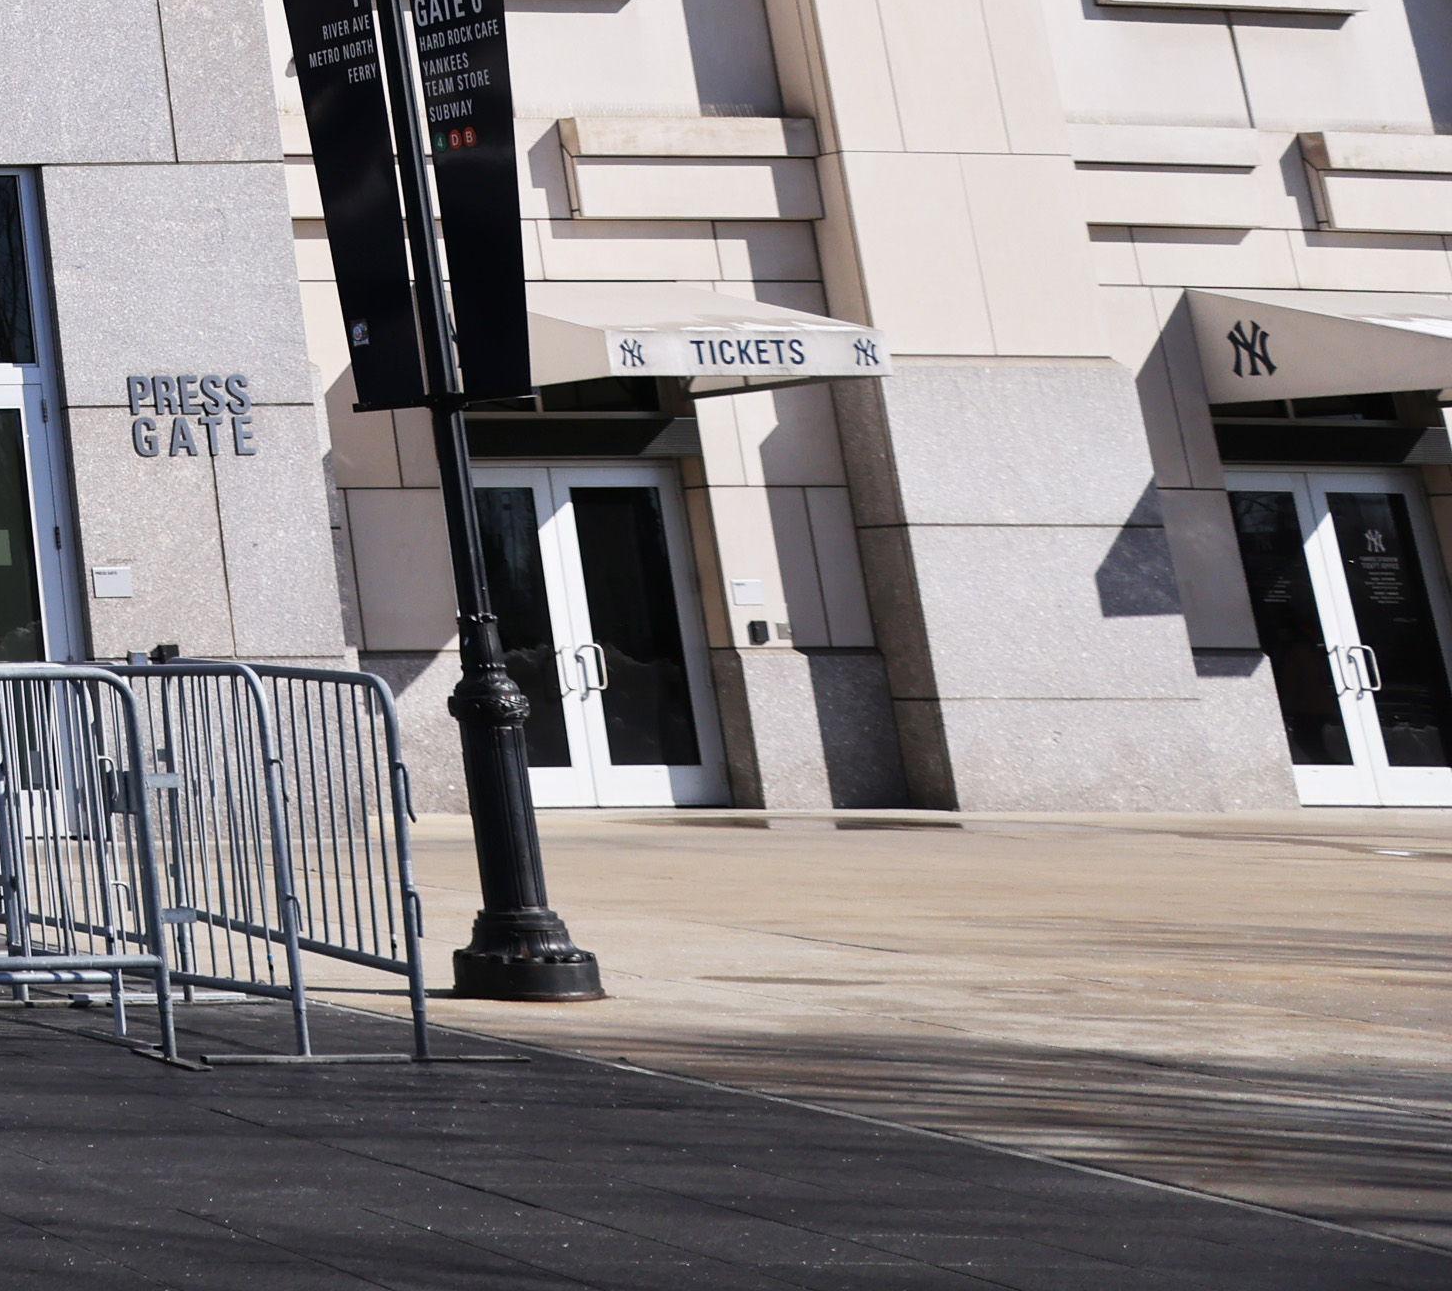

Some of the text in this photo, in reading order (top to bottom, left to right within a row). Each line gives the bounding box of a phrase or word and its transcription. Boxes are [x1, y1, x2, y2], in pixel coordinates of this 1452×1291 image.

[322, 14, 371, 41] RIVER AVE
[419, 19, 500, 52] HARD ROCK CAFE
[309, 38, 374, 69] METRO NORTH
[422, 52, 469, 77] YANKEES
[348, 62, 377, 84] FERRY
[425, 69, 491, 97] TEAM STORE
[429, 99, 473, 123] SUBWAY
[452, 131, 459, 146] D
[465, 131, 473, 143] B
[690, 339, 805, 365] TICKETS
[127, 374, 252, 416] PRESS
[131, 416, 257, 457] GATE
